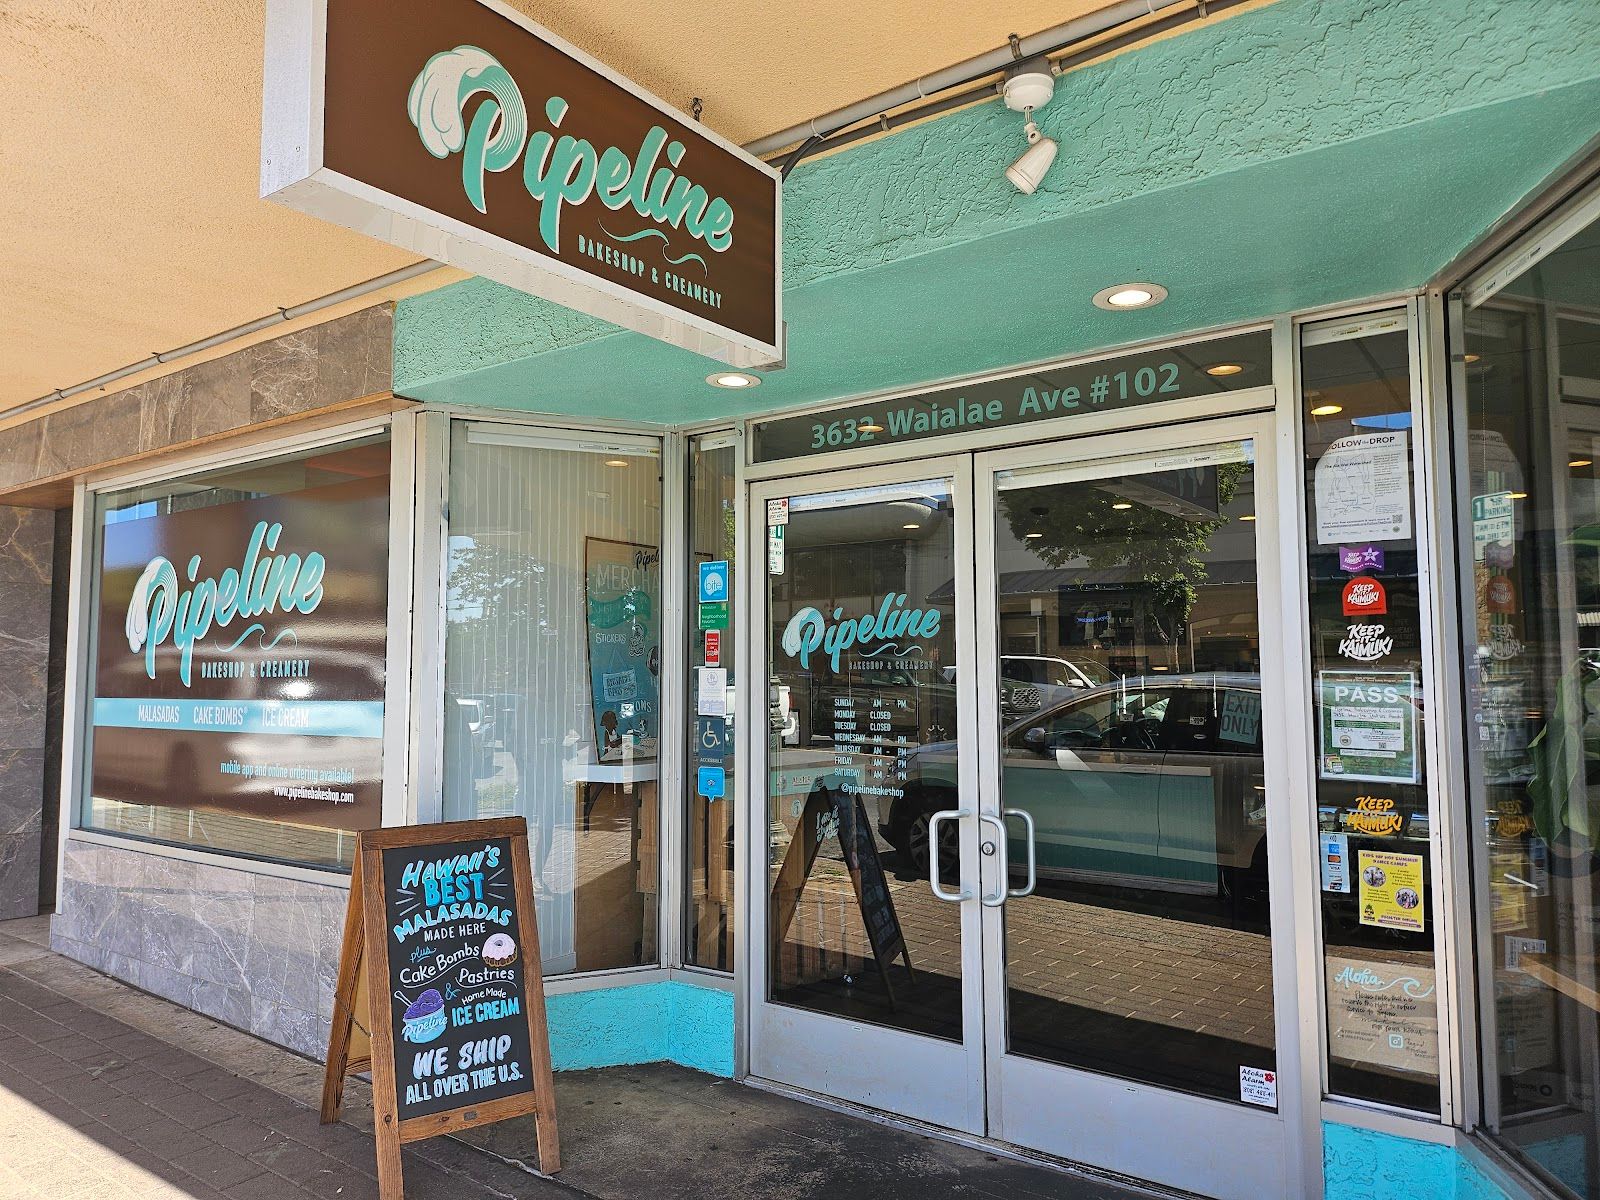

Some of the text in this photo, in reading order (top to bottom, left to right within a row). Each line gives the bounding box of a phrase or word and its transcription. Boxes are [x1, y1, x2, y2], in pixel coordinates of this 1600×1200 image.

[408, 45, 734, 252] Pipeline
[578, 234, 721, 309] BAKESHOP & CREAMERY
[811, 362, 1180, 449] 3632 Waialae Ave #102
[1370, 436, 1395, 446] DROP
[705, 580, 722, 591] bite
[1352, 583, 1374, 593] KEEP
[126, 521, 326, 688] Pipeline
[595, 632, 628, 644] STICKERS
[781, 592, 941, 674] Pipeline
[1347, 623, 1385, 640] KEEP
[1338, 636, 1393, 658] KAIMUKI
[202, 659, 310, 680] BAKESHOP & CREAMERY
[848, 660, 884, 671] BAKESHOP
[834, 698, 855, 707] SUNDAY
[873, 699, 882, 708] AM
[897, 699, 907, 708] PM
[1334, 686, 1399, 704] PASS
[1226, 694, 1261, 716] EXIT
[138, 704, 180, 723] MALASADAS
[193, 705, 213, 725] CAKE
[262, 706, 277, 727] ICE
[278, 707, 310, 728] CREAM
[834, 710, 891, 720] MONDAY CLOSED
[834, 722, 891, 732] TUESDAY CLOSED
[1222, 715, 1259, 736] ONLY
[834, 733, 907, 744] WEDNESDAY AM PM
[873, 746, 882, 755] AM
[897, 748, 907, 757] PM
[220, 759, 241, 775] mobile
[242, 765, 254, 779] app
[255, 764, 267, 777] and
[268, 763, 288, 779] online
[289, 765, 318, 784] ordering
[834, 756, 853, 765] FRIDAY
[873, 758, 883, 767] AM
[897, 759, 907, 769] PM
[834, 768, 860, 777] SATURDAY
[873, 770, 883, 779] AM
[897, 771, 907, 781] PM
[273, 785, 354, 804] www.pipelinebakeshop.com
[841, 782, 904, 799] @pipelinebakeshop
[1355, 796, 1394, 812] KEEP
[1346, 811, 1402, 833] KAIMUKI
[401, 845, 500, 889] HAWAII'S
[424, 871, 484, 907] BEST
[393, 902, 512, 944] MALASADAS
[424, 921, 487, 942] MADE HERE
[410, 944, 437, 963] plus
[400, 942, 480, 985] Cake Bombs
[459, 966, 515, 983] Pastries
[444, 981, 462, 1000] &
[462, 986, 507, 1005] Home Made
[451, 997, 521, 1027] ICE CREAM
[401, 1015, 450, 1042] Pipeline
[413, 1034, 512, 1081] WE SHIP
[1241, 1068, 1264, 1078] Aloha
[1241, 1075, 1265, 1086] Alarm
[405, 1061, 524, 1105] ALL OVER THE U.S.
